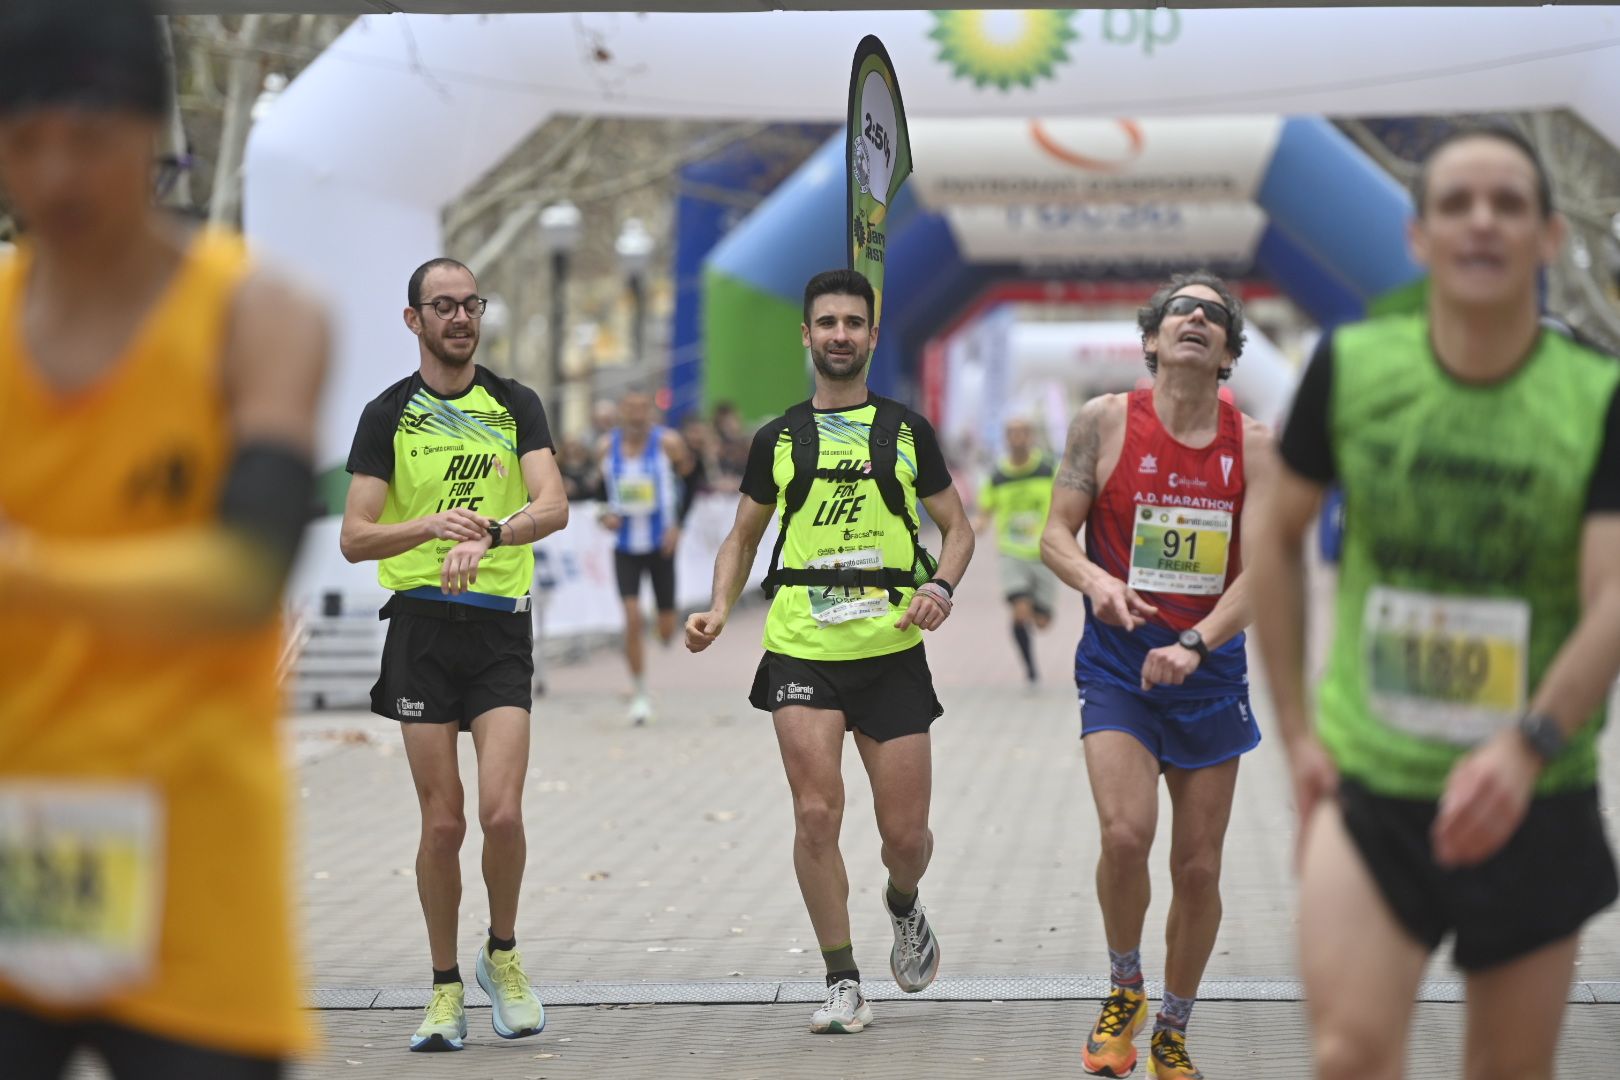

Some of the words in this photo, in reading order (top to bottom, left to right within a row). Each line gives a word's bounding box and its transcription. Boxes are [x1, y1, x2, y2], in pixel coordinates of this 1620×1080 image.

[443, 453, 497, 481] RUN
[448, 481, 475, 497] FOR
[832, 482, 859, 499] FOR
[812, 494, 867, 527] LIFE
[1134, 491, 1159, 504] A.D.
[1162, 494, 1234, 511] MARATHON
[1163, 529, 1197, 560] 91
[1157, 558, 1201, 573] FREIRE
